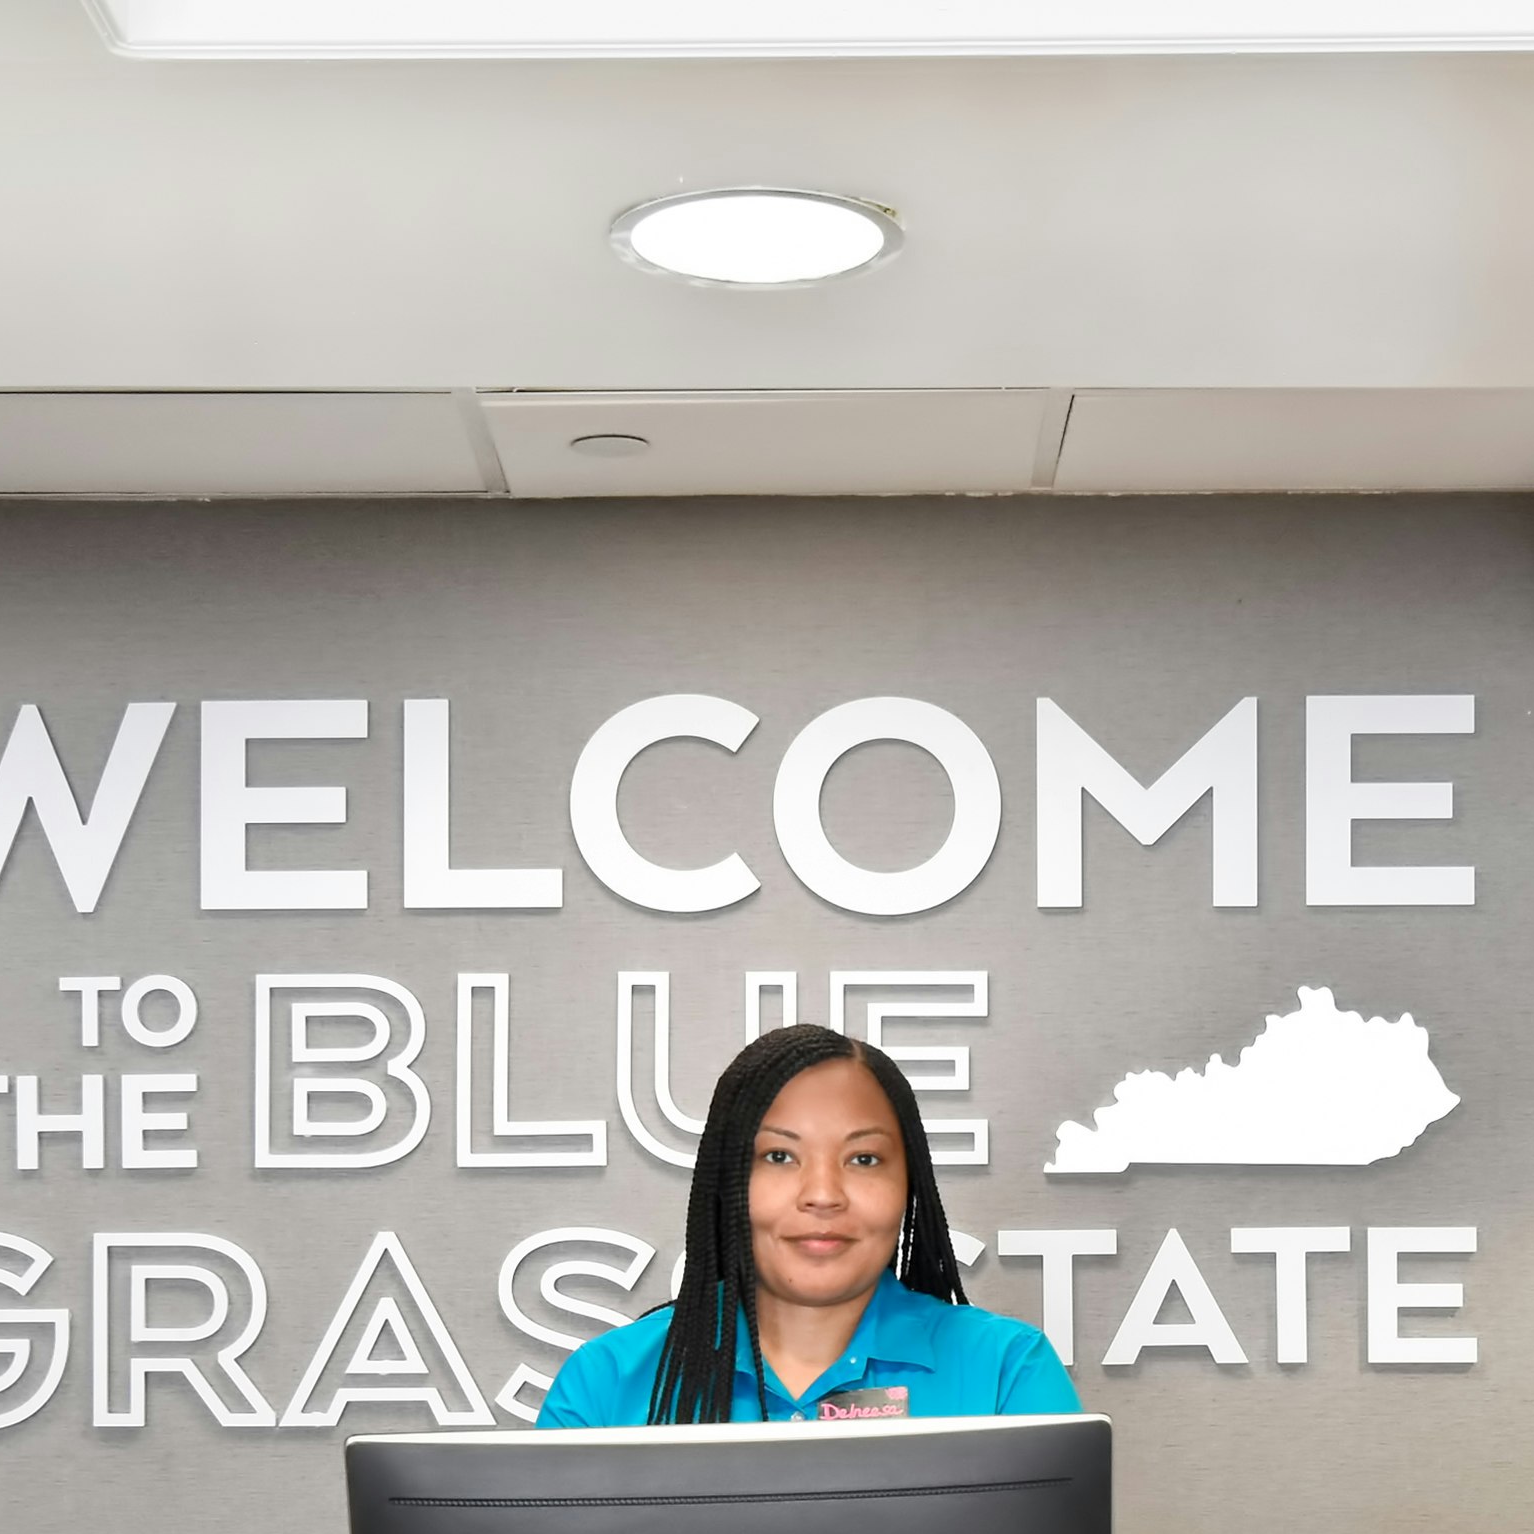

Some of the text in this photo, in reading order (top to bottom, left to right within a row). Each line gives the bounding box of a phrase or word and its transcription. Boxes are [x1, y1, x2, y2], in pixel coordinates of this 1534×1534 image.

[59, 973, 198, 1048] TO
[254, 970, 989, 1169] BLUE
[949, 1224, 1479, 1366] TATE
